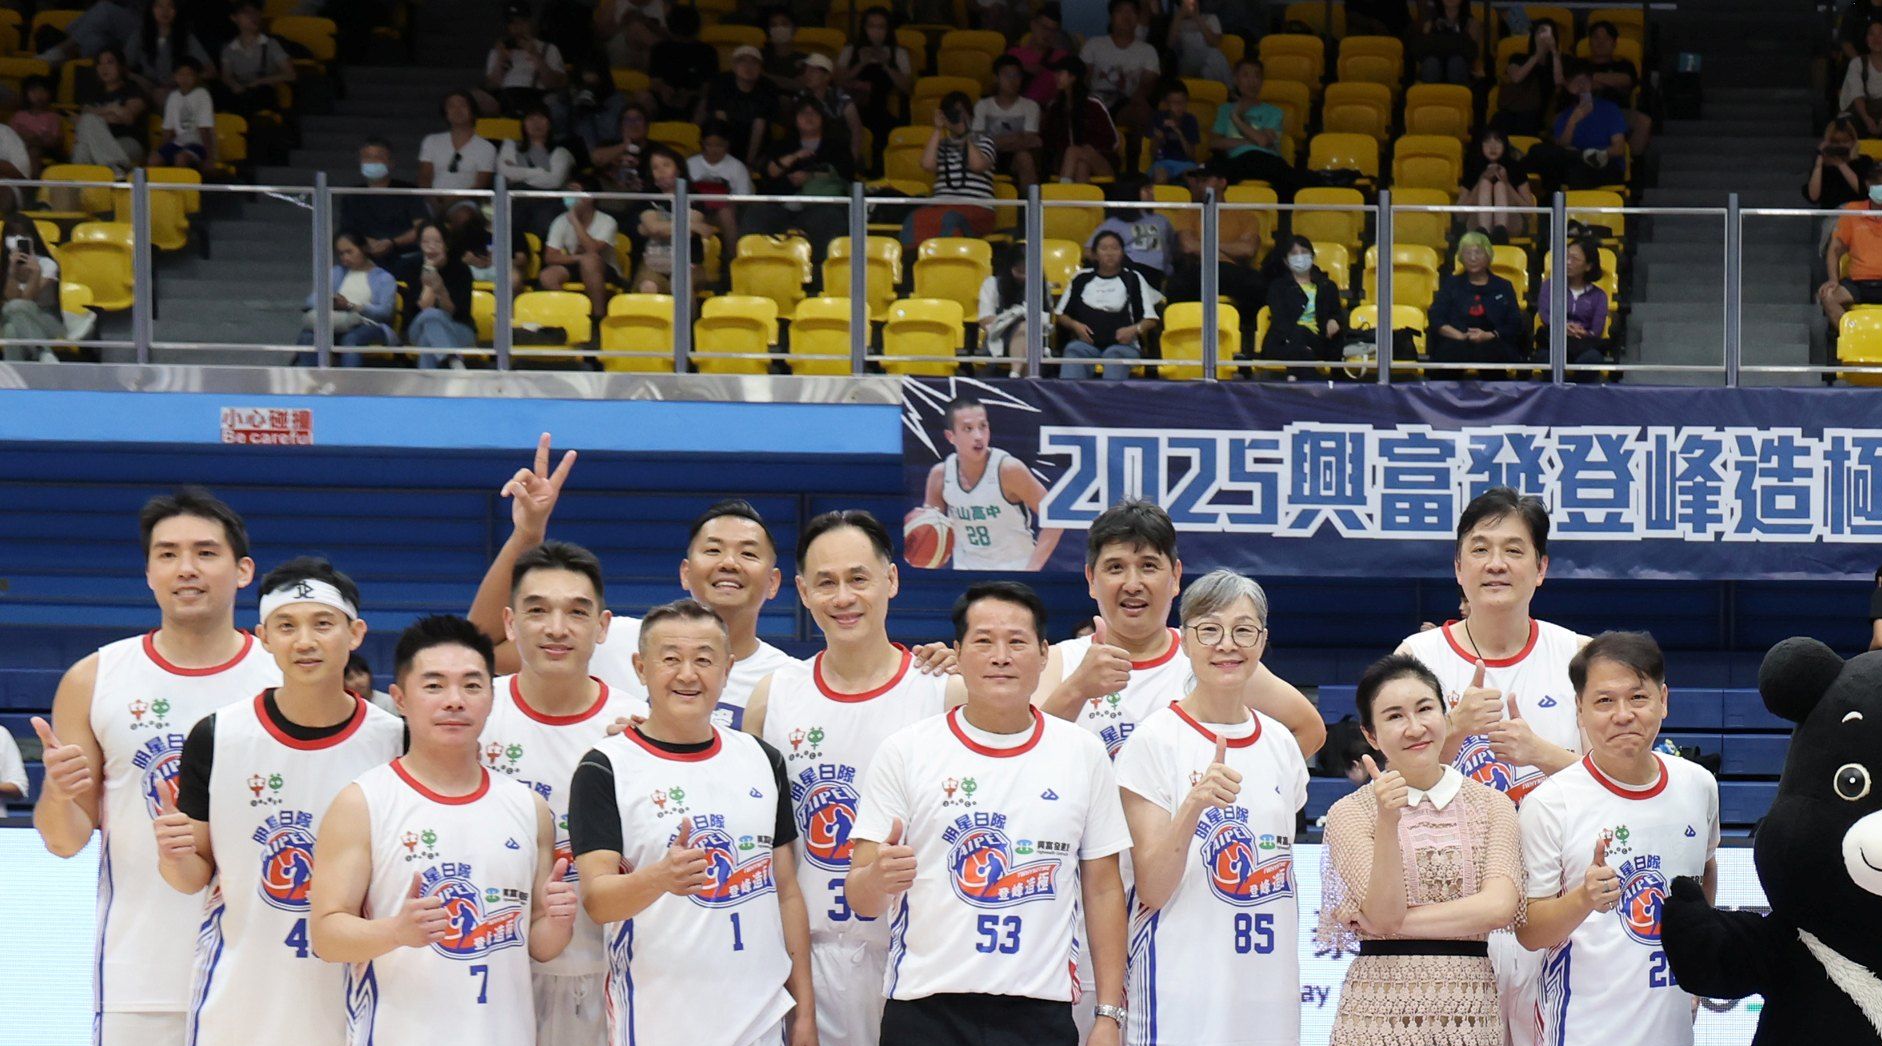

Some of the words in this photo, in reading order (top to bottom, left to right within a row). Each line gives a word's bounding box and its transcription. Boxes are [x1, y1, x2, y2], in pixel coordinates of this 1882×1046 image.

[222, 429, 246, 444] Be
[946, 505, 1001, 521] 山高中
[965, 526, 991, 546] 28
[827, 878, 878, 922] 3
[730, 912, 744, 951] 1
[975, 913, 1023, 955] 53
[1234, 913, 1275, 955] 85
[470, 964, 488, 1004] 7
[1649, 950, 1680, 989] 2
